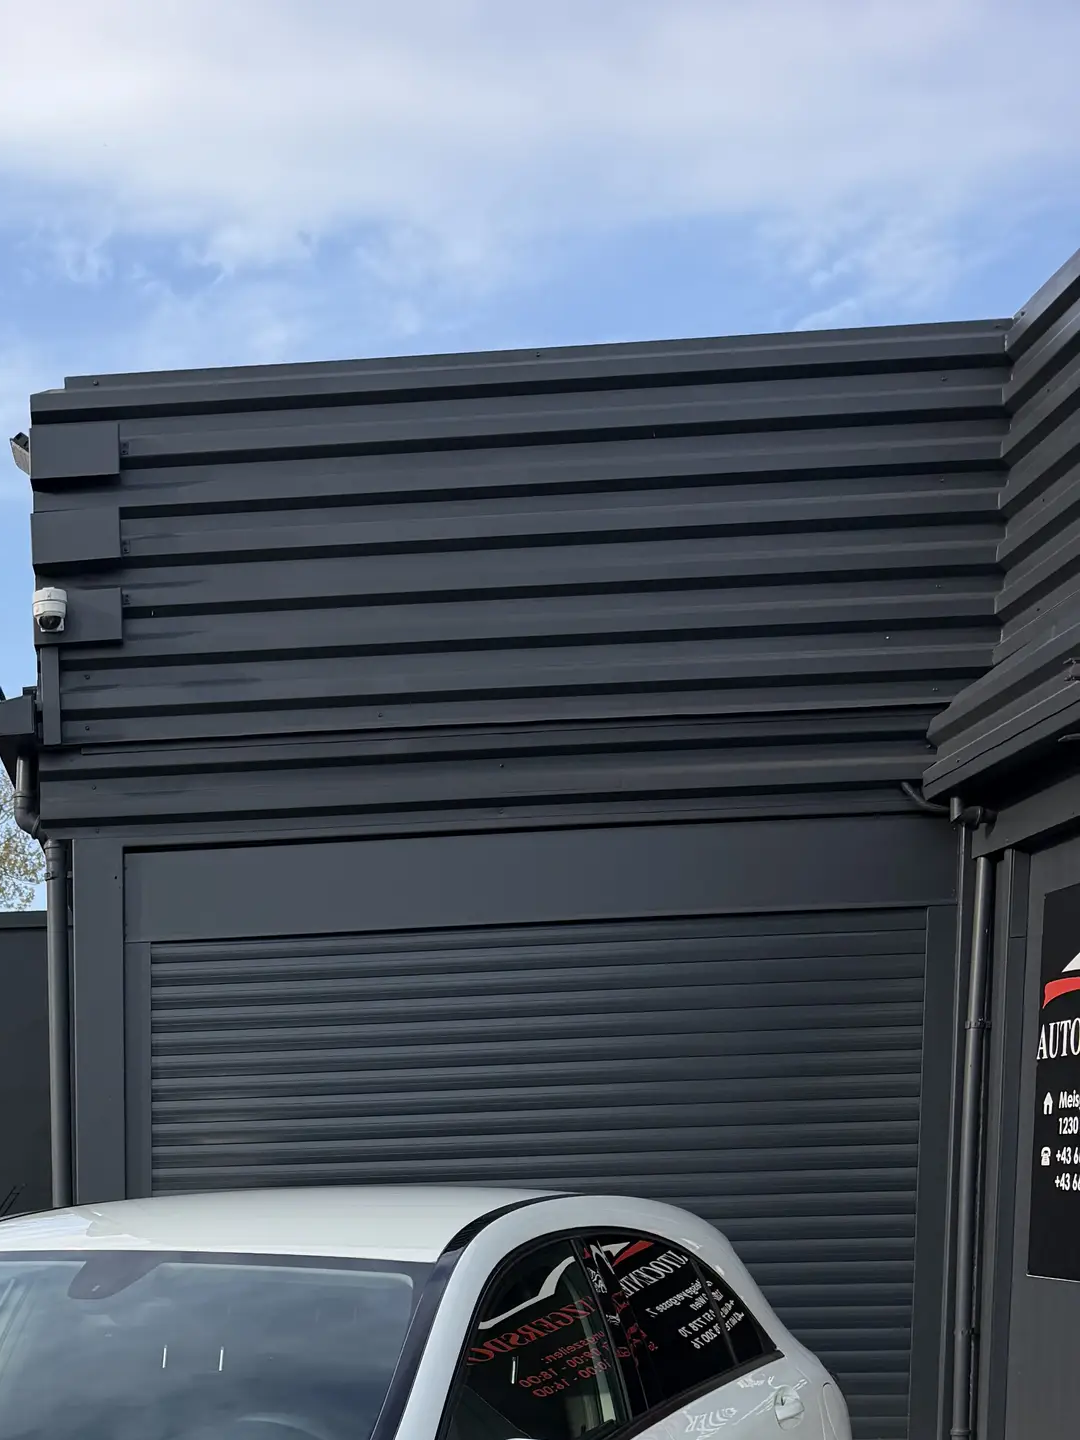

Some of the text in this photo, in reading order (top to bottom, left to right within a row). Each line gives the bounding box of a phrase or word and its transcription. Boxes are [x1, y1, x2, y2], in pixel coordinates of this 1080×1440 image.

[1059, 1089, 1080, 1109] Meis
[1058, 1116, 1079, 1135] 1230
[1056, 1146, 1072, 1165] +43
[1054, 1172, 1070, 1191] +43
